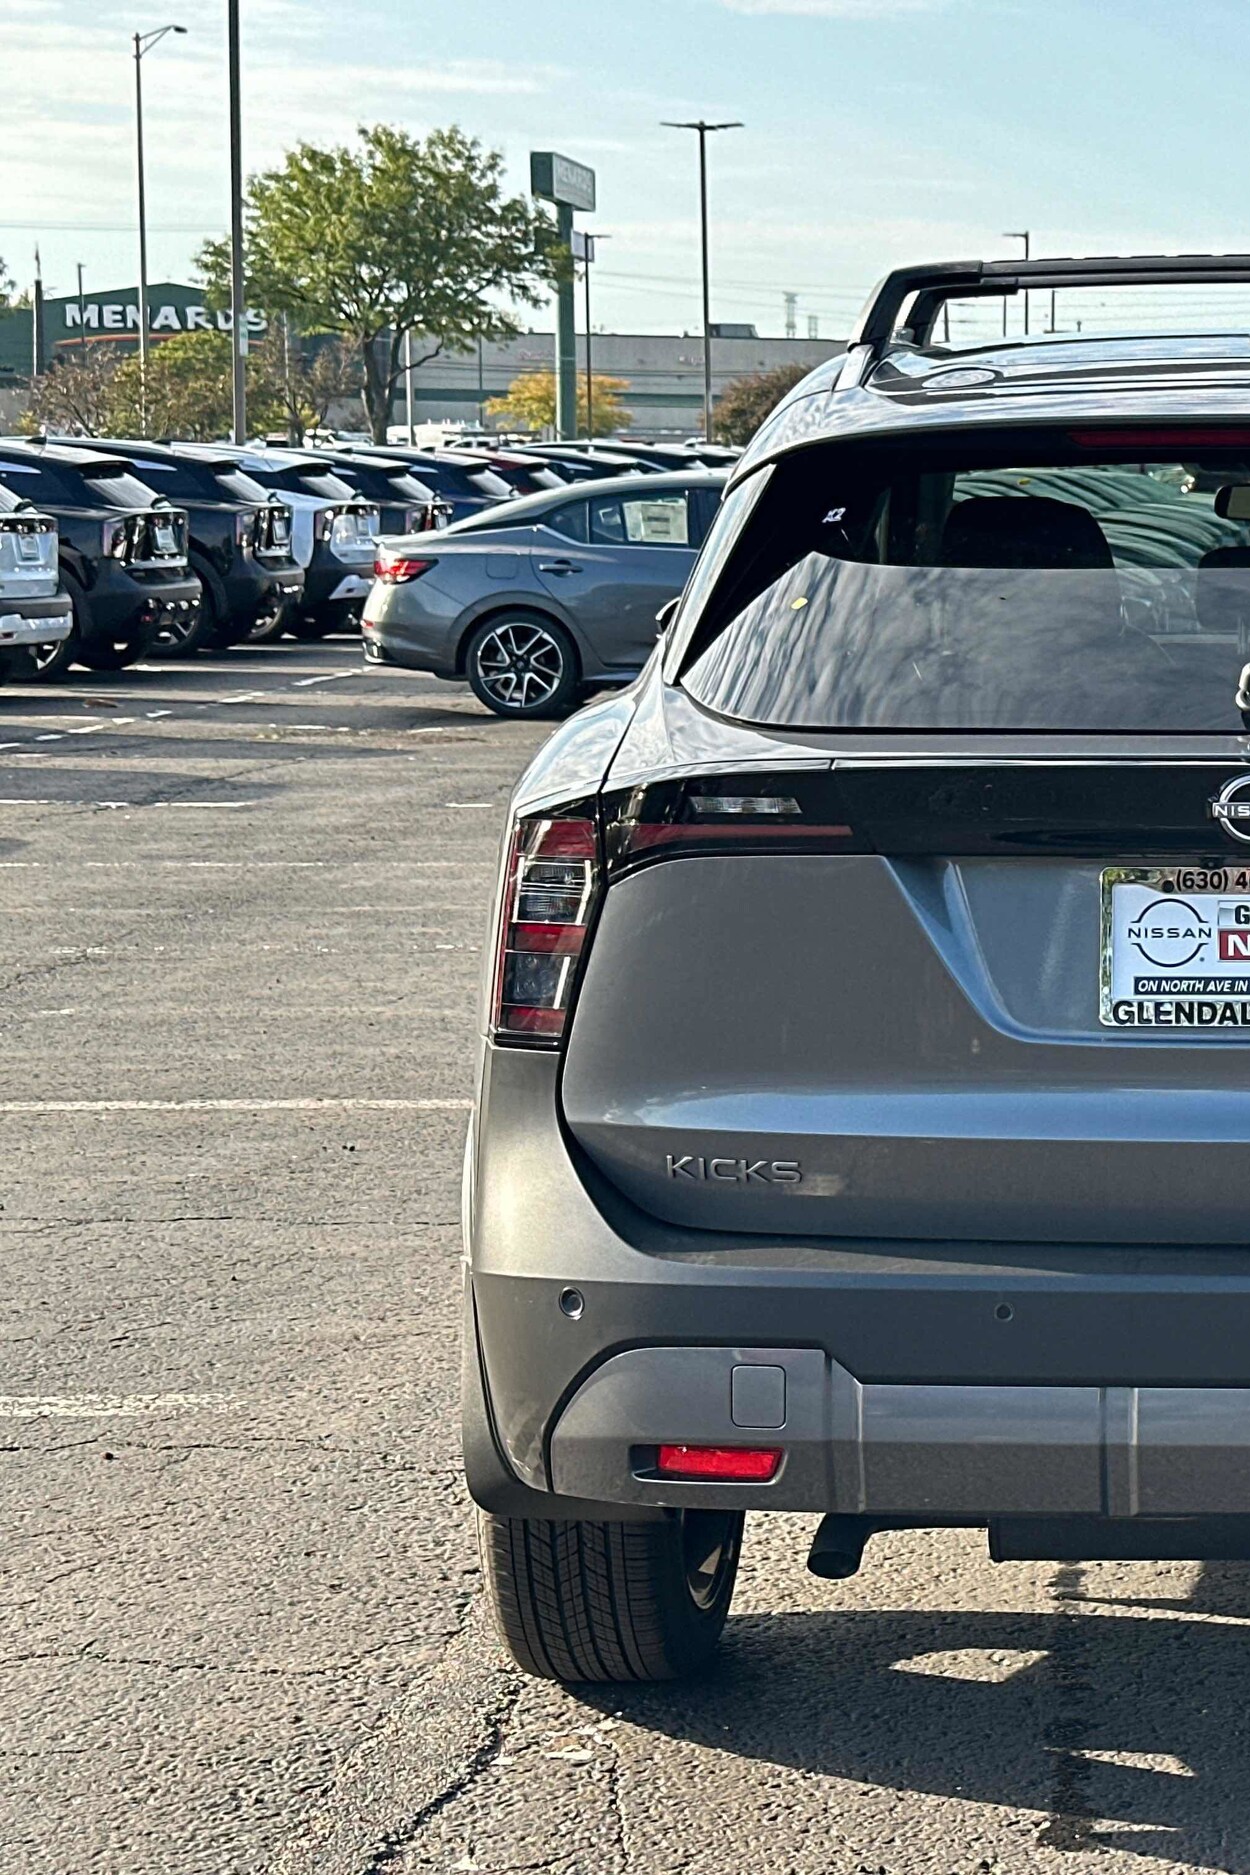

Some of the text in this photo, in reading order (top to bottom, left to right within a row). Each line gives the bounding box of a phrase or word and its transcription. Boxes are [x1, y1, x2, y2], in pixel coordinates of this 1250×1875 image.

[1176, 869, 1228, 892] (630)
[1128, 927, 1212, 938] NISSAN
[1138, 979, 1158, 992] ON
[1160, 979, 1204, 992] NORTH
[1206, 979, 1232, 992] AVE
[1234, 979, 1248, 992] IN
[666, 1154, 802, 1183] KICKS
